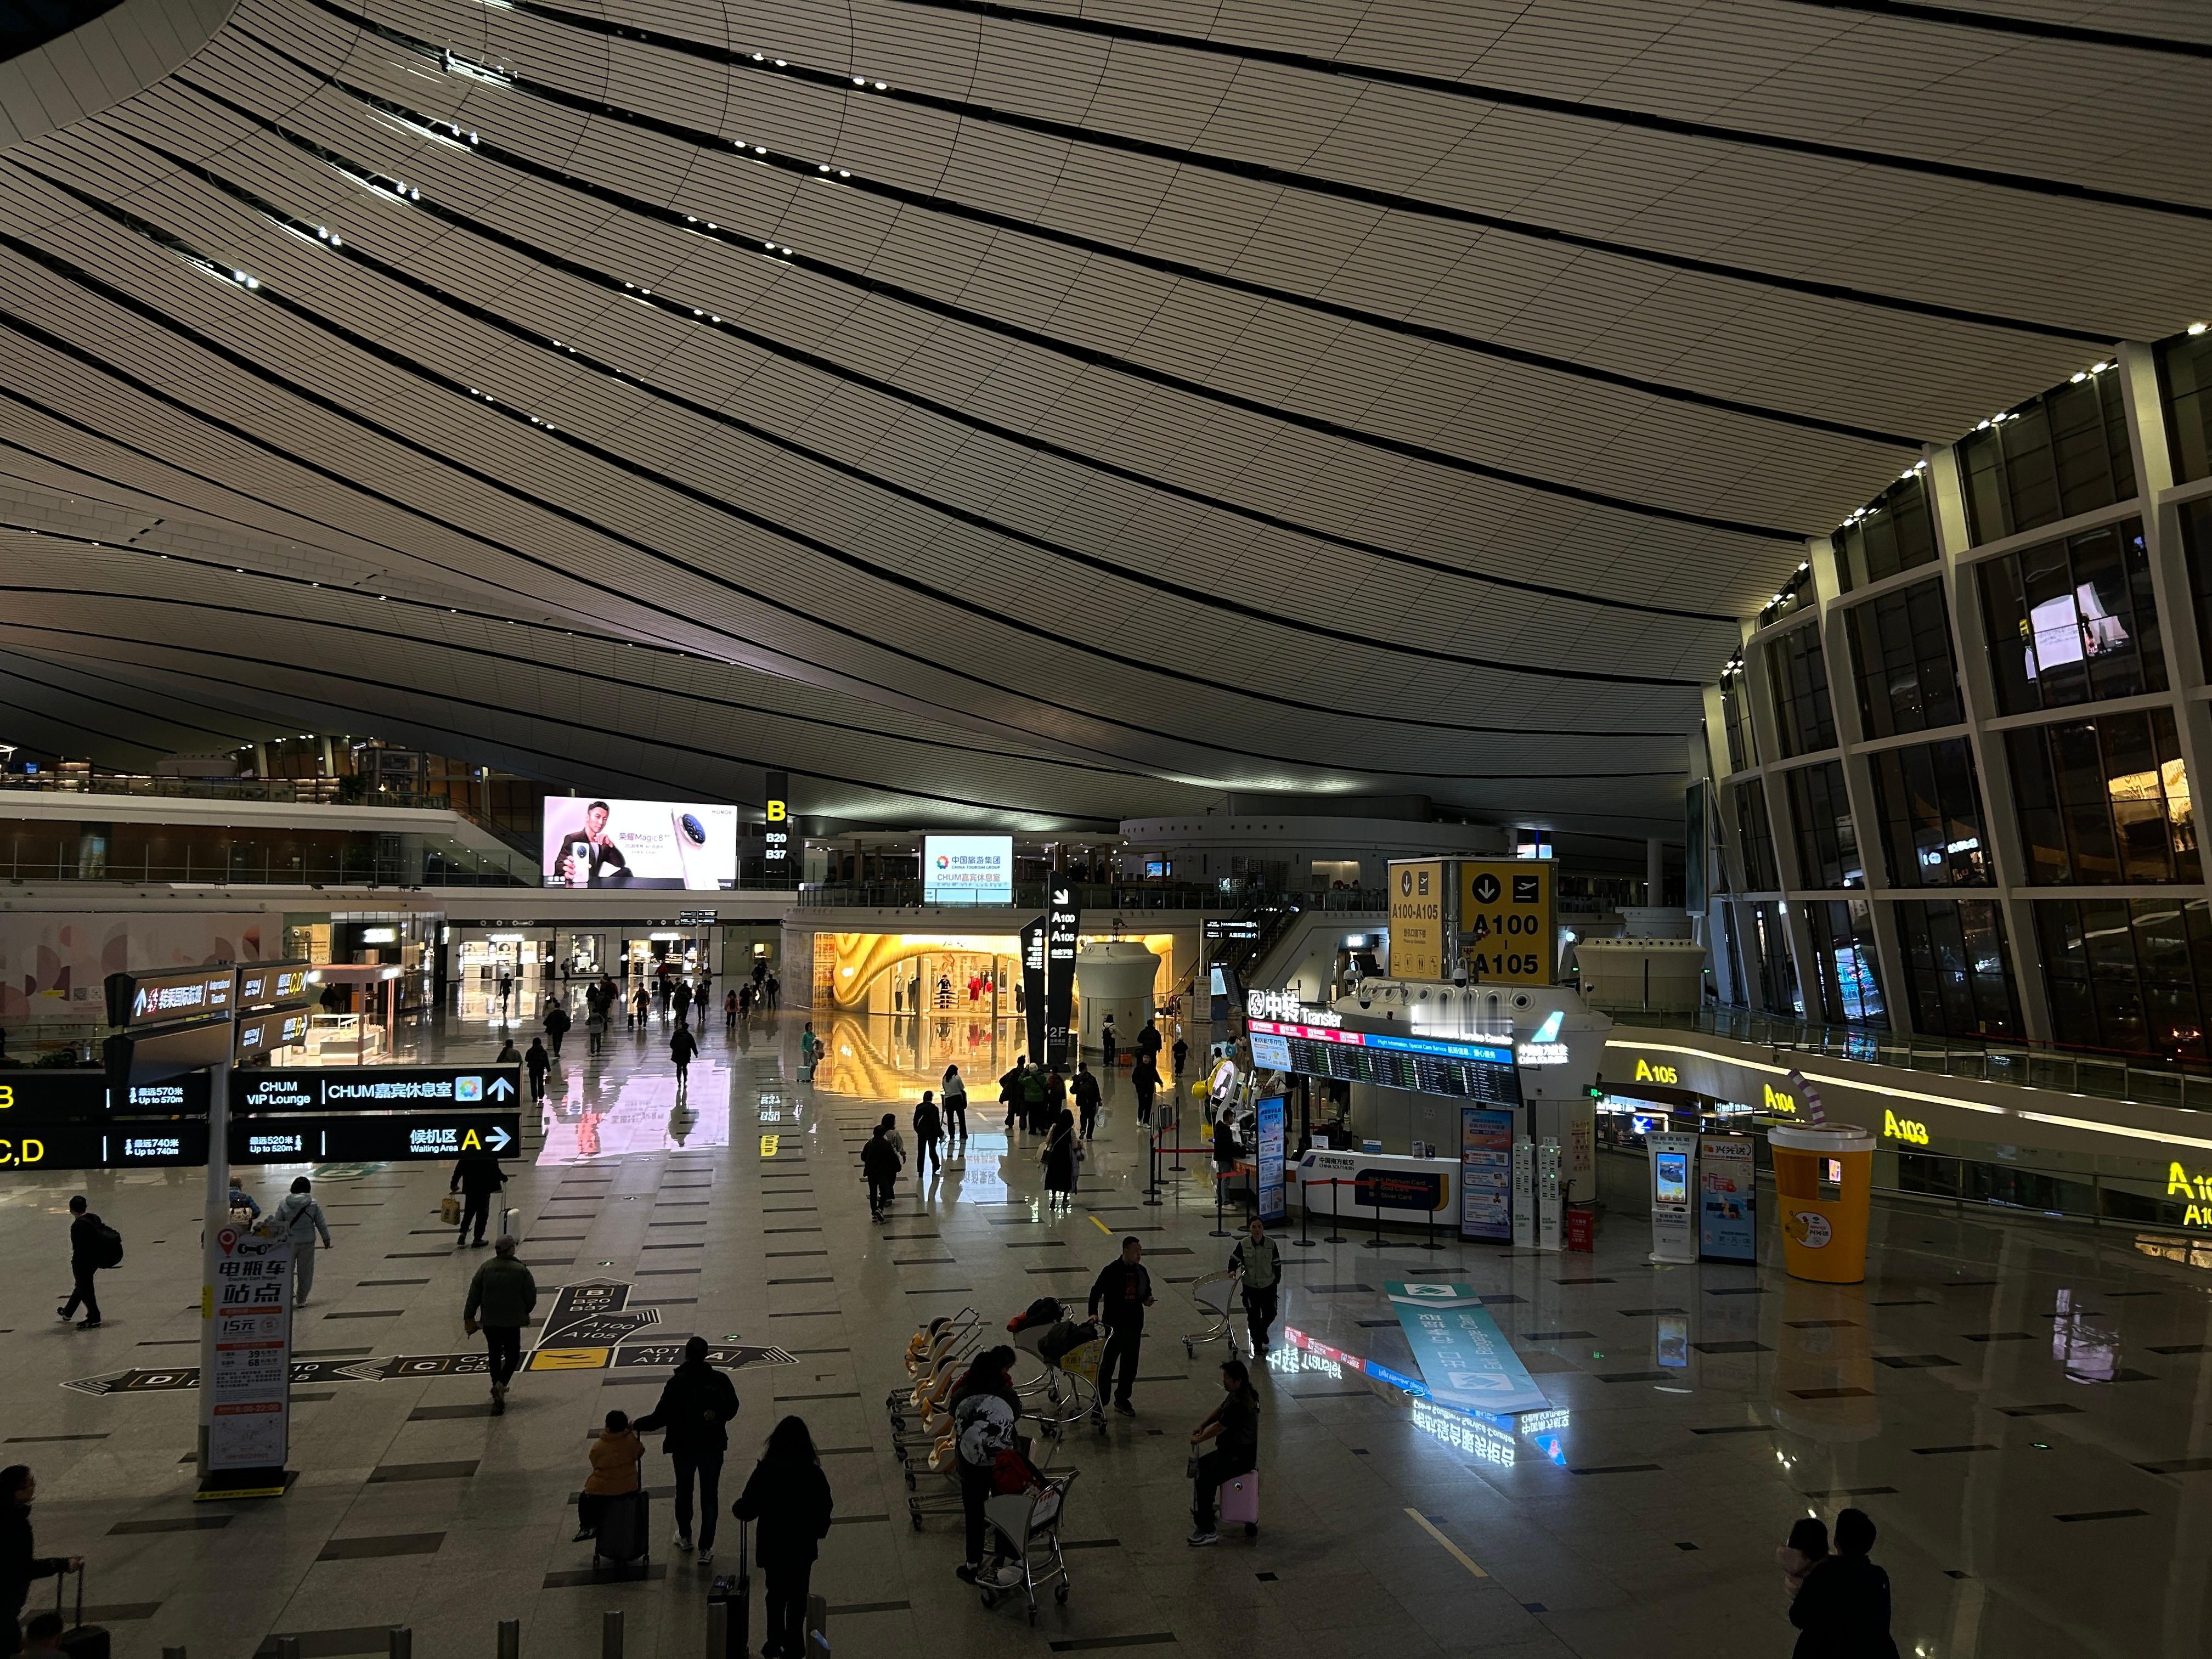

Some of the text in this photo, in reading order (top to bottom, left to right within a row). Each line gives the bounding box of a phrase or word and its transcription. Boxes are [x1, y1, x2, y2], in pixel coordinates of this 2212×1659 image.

[768, 800, 786, 821] B
[766, 833, 787, 843] B20
[766, 850, 787, 859] B37
[952, 856, 1001, 864] 中国旅游集团
[938, 873, 1001, 882] CHUM嘉宾休息室
[1392, 904, 1438, 919] A100-A105
[1052, 912, 1075, 923] A100
[1473, 914, 1538, 935] A100
[1052, 931, 1075, 942] A105
[1472, 953, 1538, 974] A105
[290, 973, 303, 995] C,D
[1266, 991, 1300, 1023] 中转
[1301, 1008, 1342, 1028] Transfer
[295, 1017, 302, 1036] B
[1050, 1027, 1066, 1037] 2F
[1635, 1059, 1678, 1085] A105
[138, 1087, 183, 1096] 最远570米
[260, 1082, 452, 1099] CHUM CHUM嘉宾休息室
[138, 1096, 150, 1104] Up
[247, 1094, 311, 1106] VIP Lounge
[1764, 1084, 1796, 1114] A104
[1883, 1109, 1929, 1144] A103
[134, 1139, 179, 1148] 最远740米
[250, 1136, 293, 1144] 最远520米
[410, 1129, 481, 1150] 候机区 A
[134, 1148, 146, 1156] Up
[250, 1144, 261, 1153] Up
[272, 1144, 292, 1152] 520m
[410, 1144, 438, 1153] Waiting
[1319, 1157, 1354, 1166] 中国南方航空
[219, 1260, 287, 1276] 电瓶车
[222, 1283, 281, 1304] 站点
[223, 1319, 255, 1331] 15元
[582, 1322, 635, 1330] A100
[1469, 1330, 1494, 1355] Baggage
[704, 1352, 724, 1360] A
[145, 1376, 173, 1384] D
